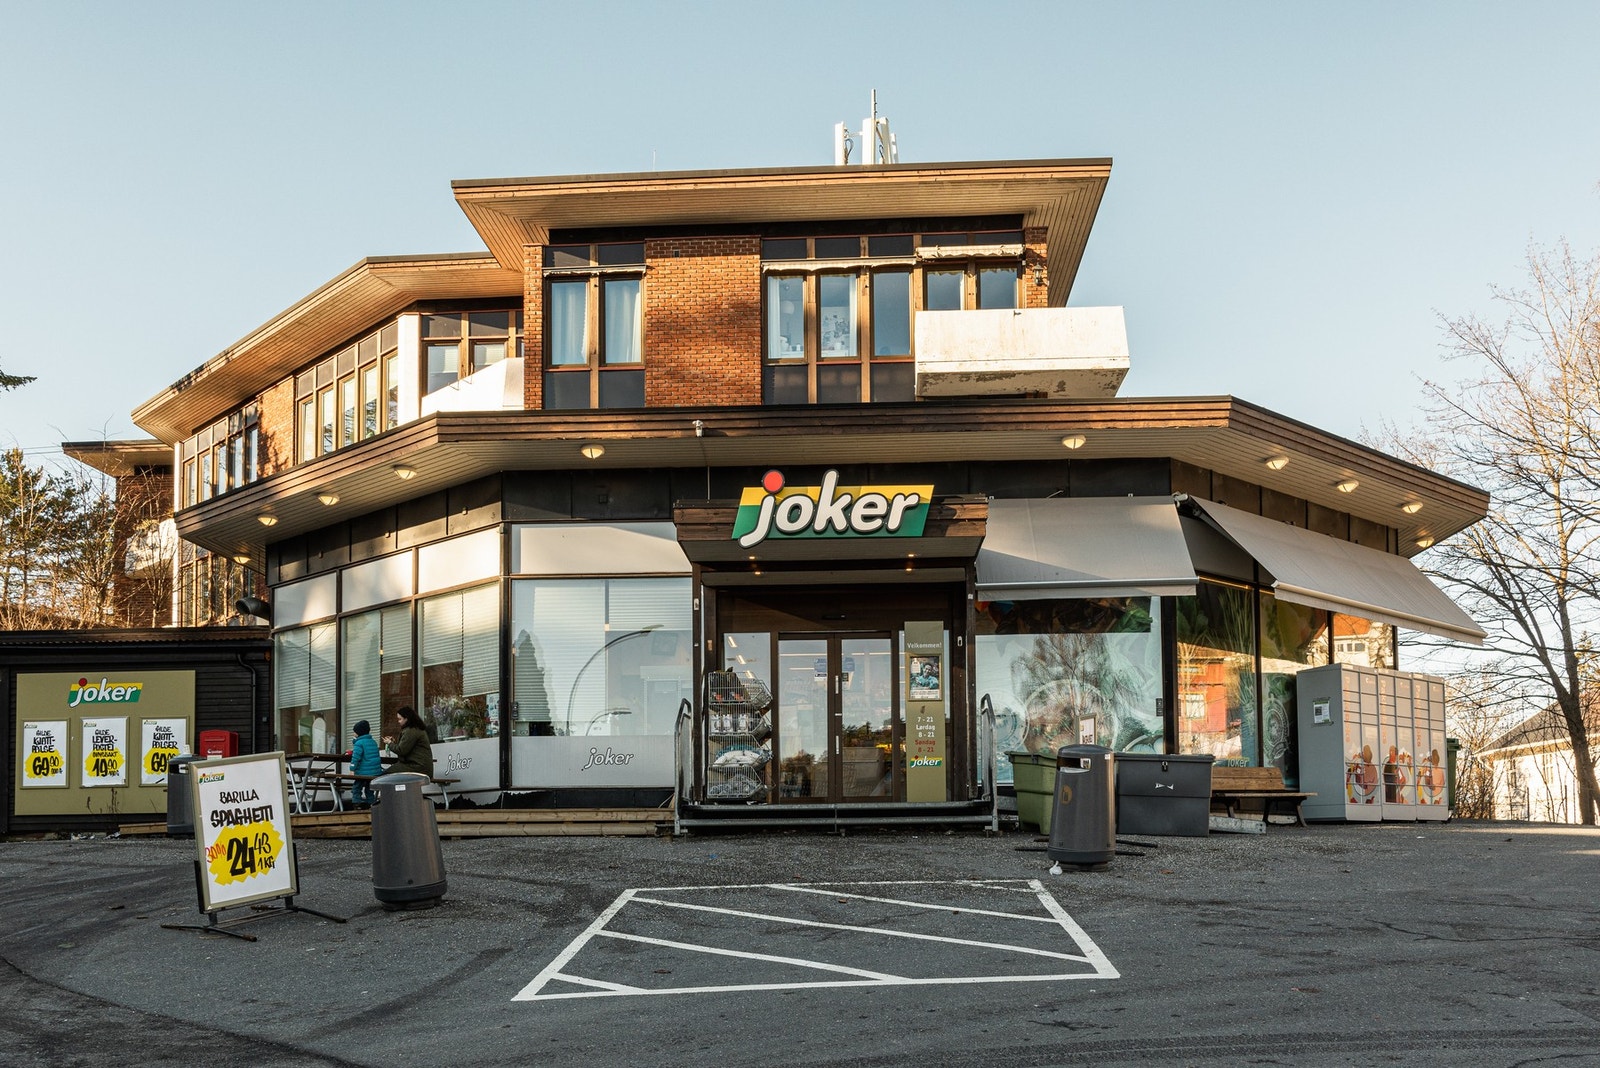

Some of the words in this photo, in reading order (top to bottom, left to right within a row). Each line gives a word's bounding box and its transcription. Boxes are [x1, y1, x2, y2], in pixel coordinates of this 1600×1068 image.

[738, 468, 920, 549] joker
[69, 678, 138, 708] joker
[33, 756, 50, 776] 69
[50, 755, 59, 767] 90
[92, 758, 108, 777] 19
[107, 758, 117, 770] 90
[151, 752, 167, 772] 69
[446, 753, 472, 775] joker
[584, 747, 634, 769] joker
[911, 755, 941, 768] joker
[200, 772, 223, 784] joker
[219, 789, 259, 804] BARILLA
[210, 804, 274, 828] SPAGHETTI
[226, 836, 256, 876] 24
